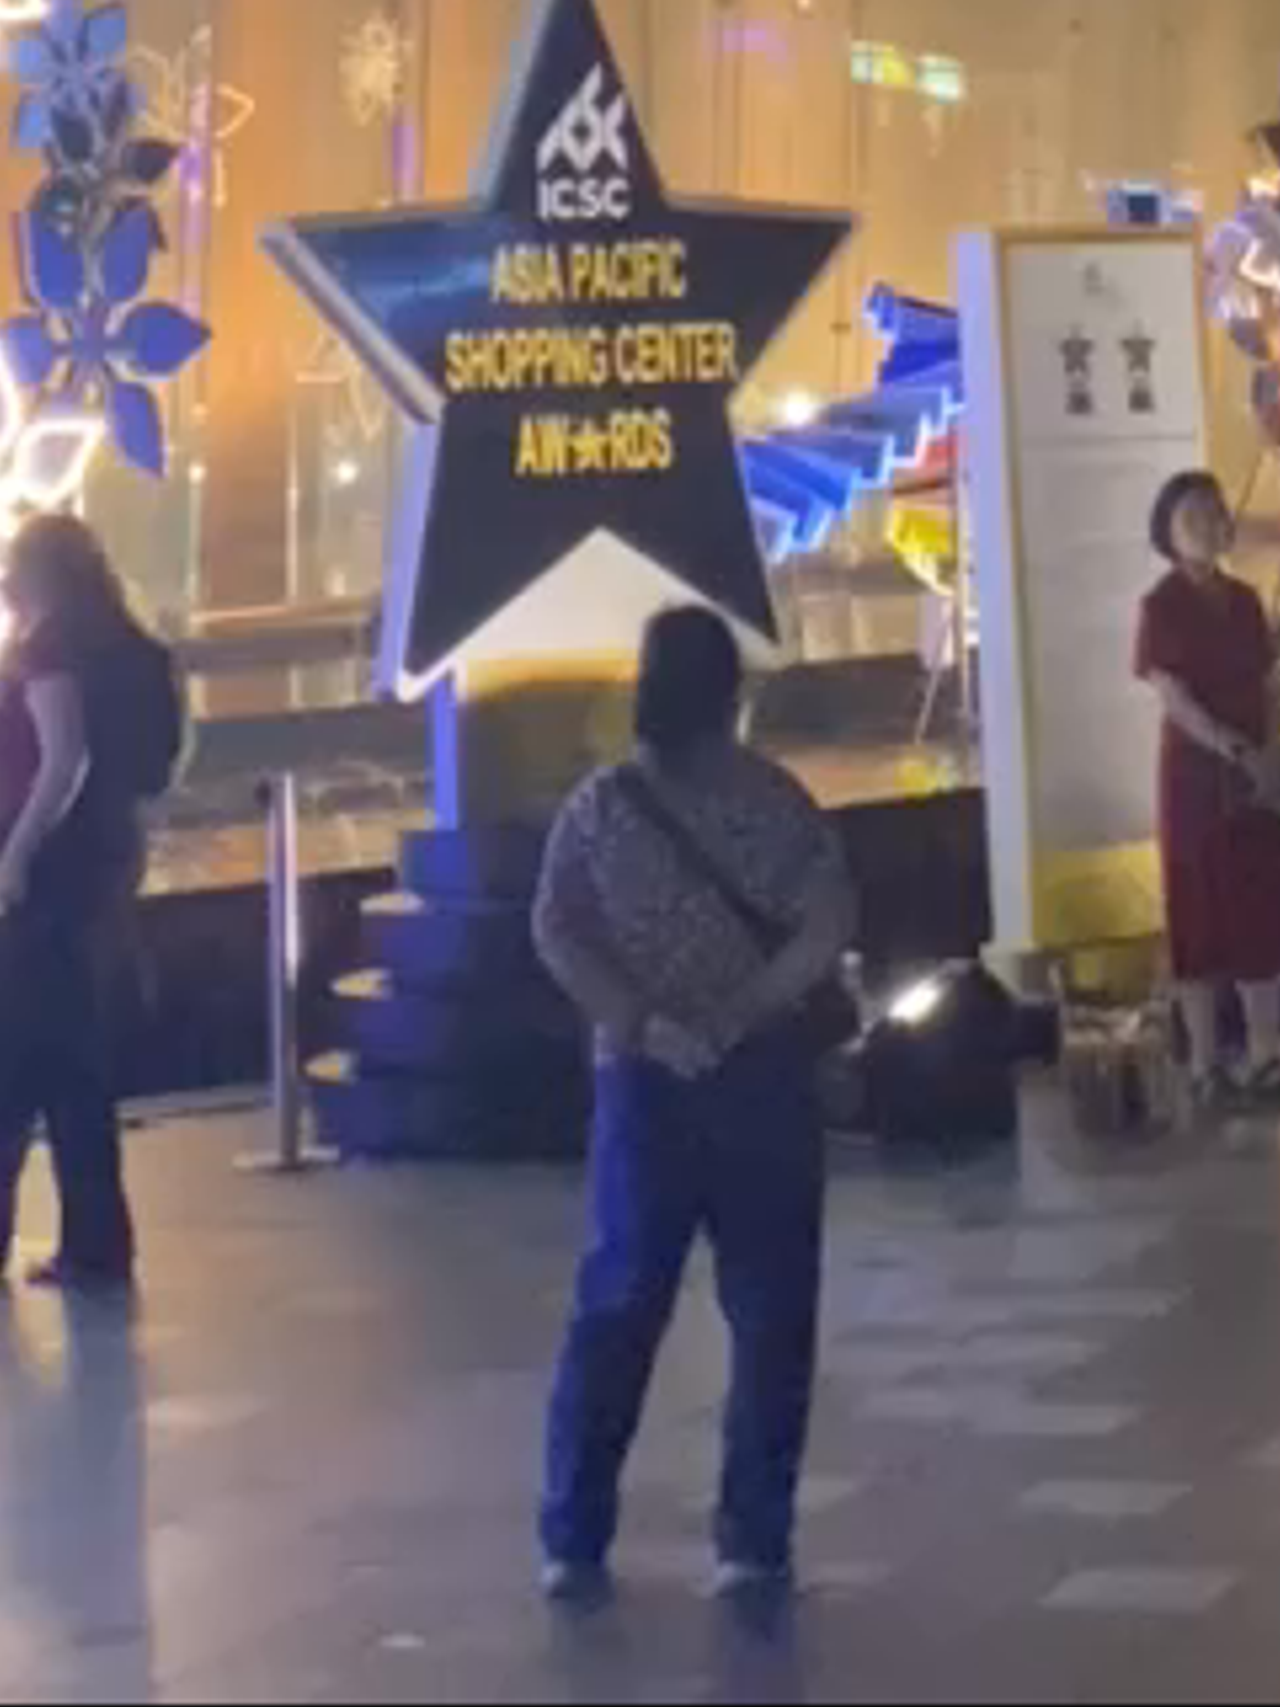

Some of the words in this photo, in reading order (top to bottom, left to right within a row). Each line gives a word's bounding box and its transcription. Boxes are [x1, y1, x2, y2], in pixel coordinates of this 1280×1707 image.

[537, 177, 631, 221] ICSC
[490, 242, 566, 304] ASIA
[572, 239, 687, 302] PACIFIC
[445, 325, 607, 392] SHOPPING
[616, 320, 739, 384] CENTER
